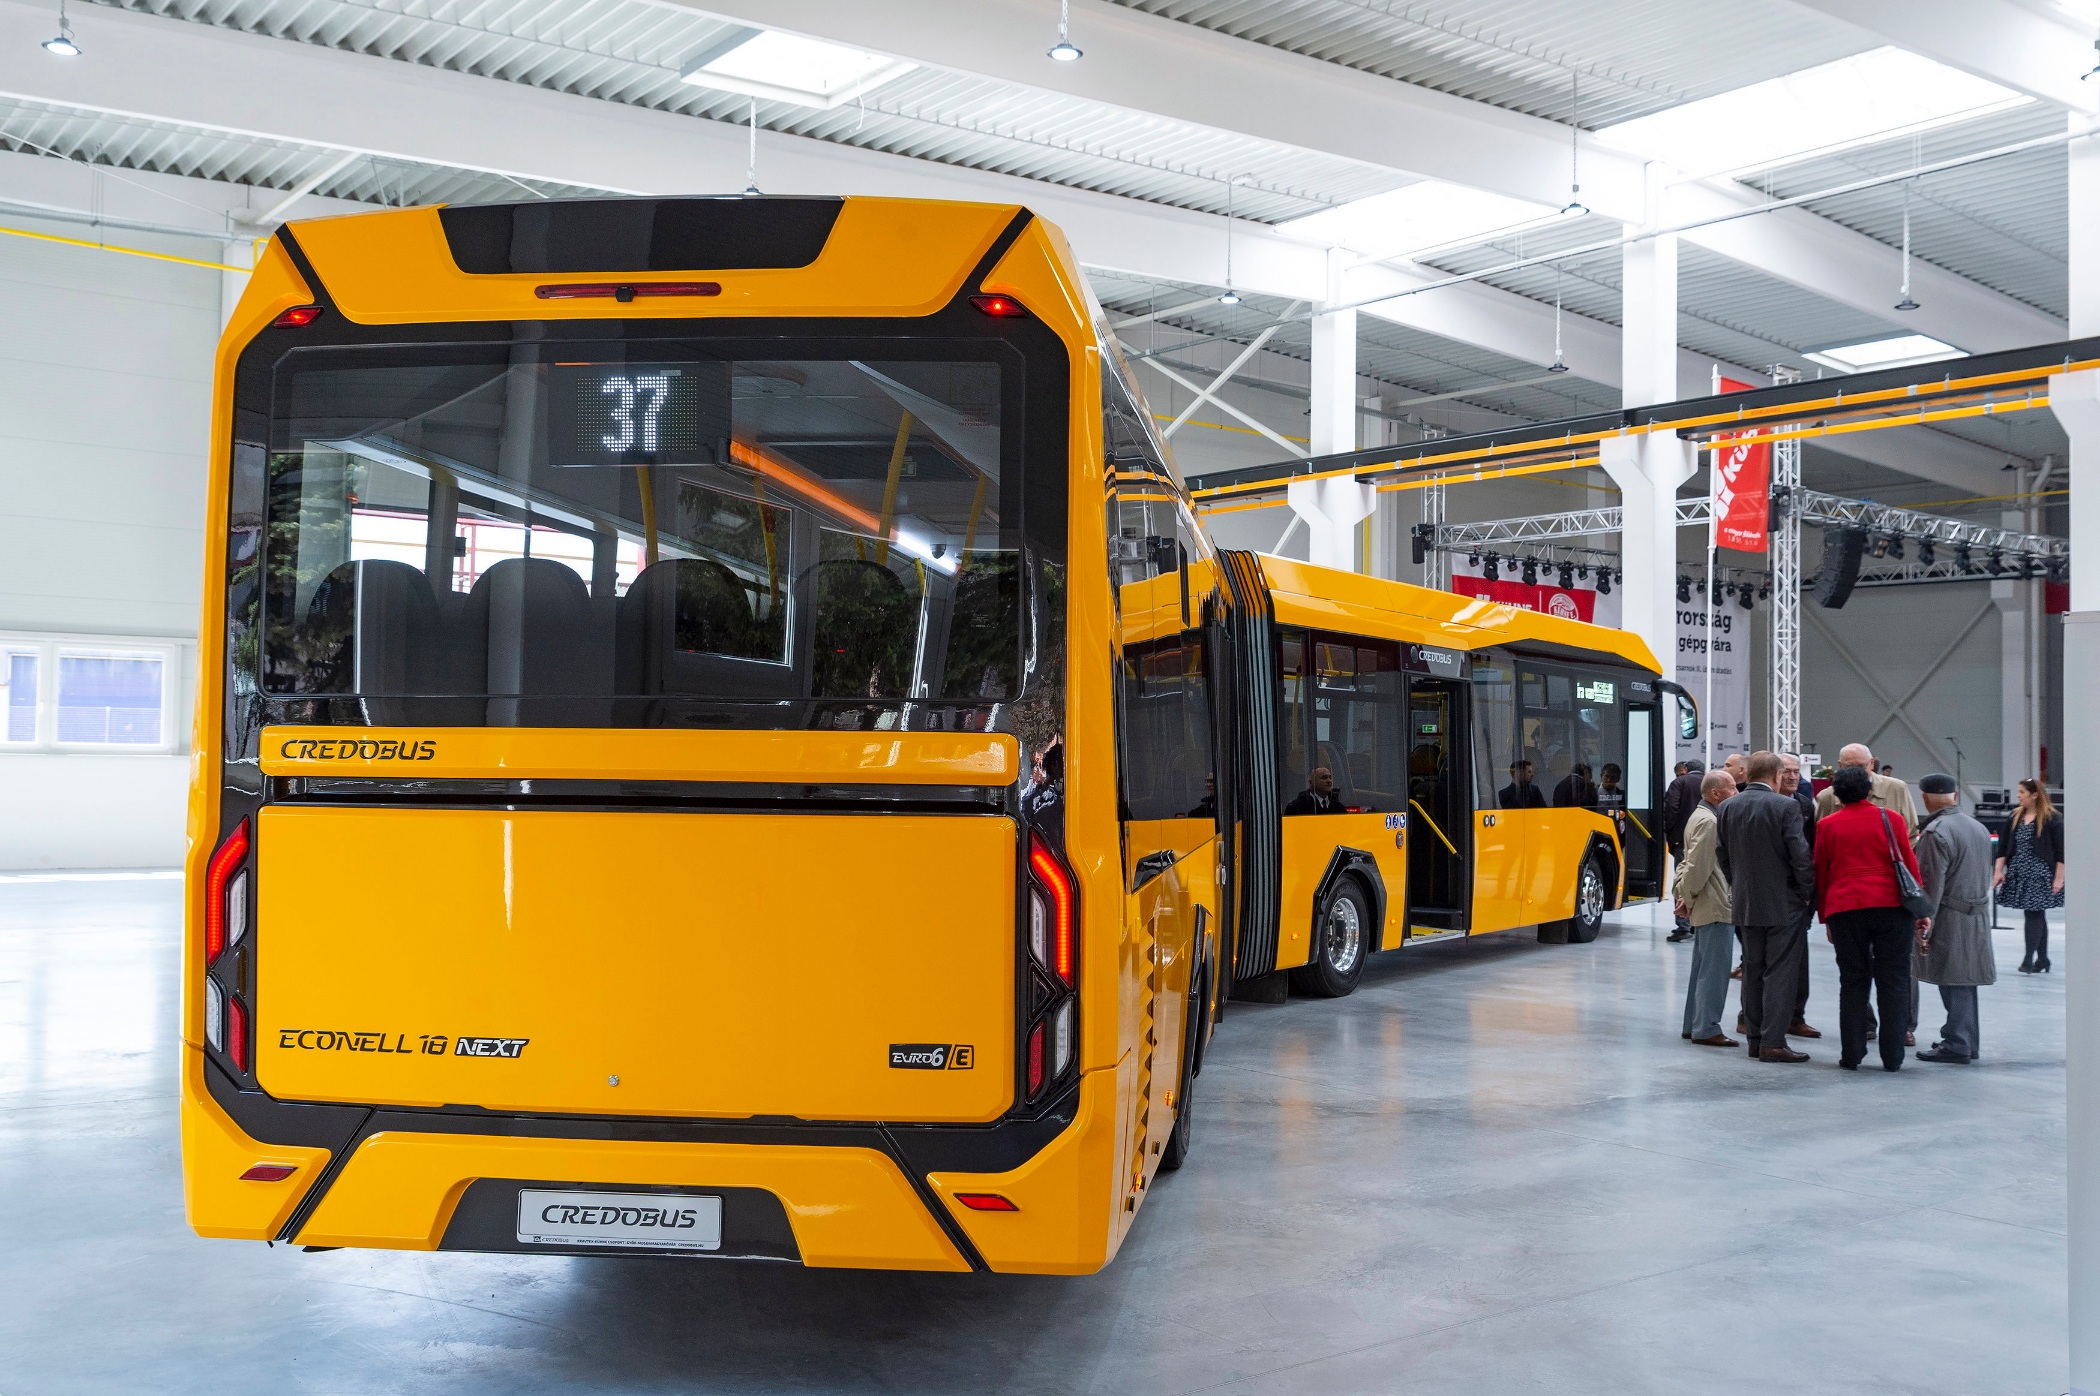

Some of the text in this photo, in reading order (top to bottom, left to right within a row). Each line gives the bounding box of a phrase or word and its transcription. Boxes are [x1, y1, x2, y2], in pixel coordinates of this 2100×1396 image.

[602, 376, 668, 452] 37
[1676, 609, 1732, 633] rorság
[1679, 634, 1732, 653] gépgára
[1418, 650, 1452, 665] CREDOBUS
[280, 739, 437, 761] CREDOBUS
[279, 1028, 528, 1058] ECONELL 18 NEXT
[892, 1047, 944, 1067] EURO6
[541, 1204, 698, 1229] CREDOBUS
